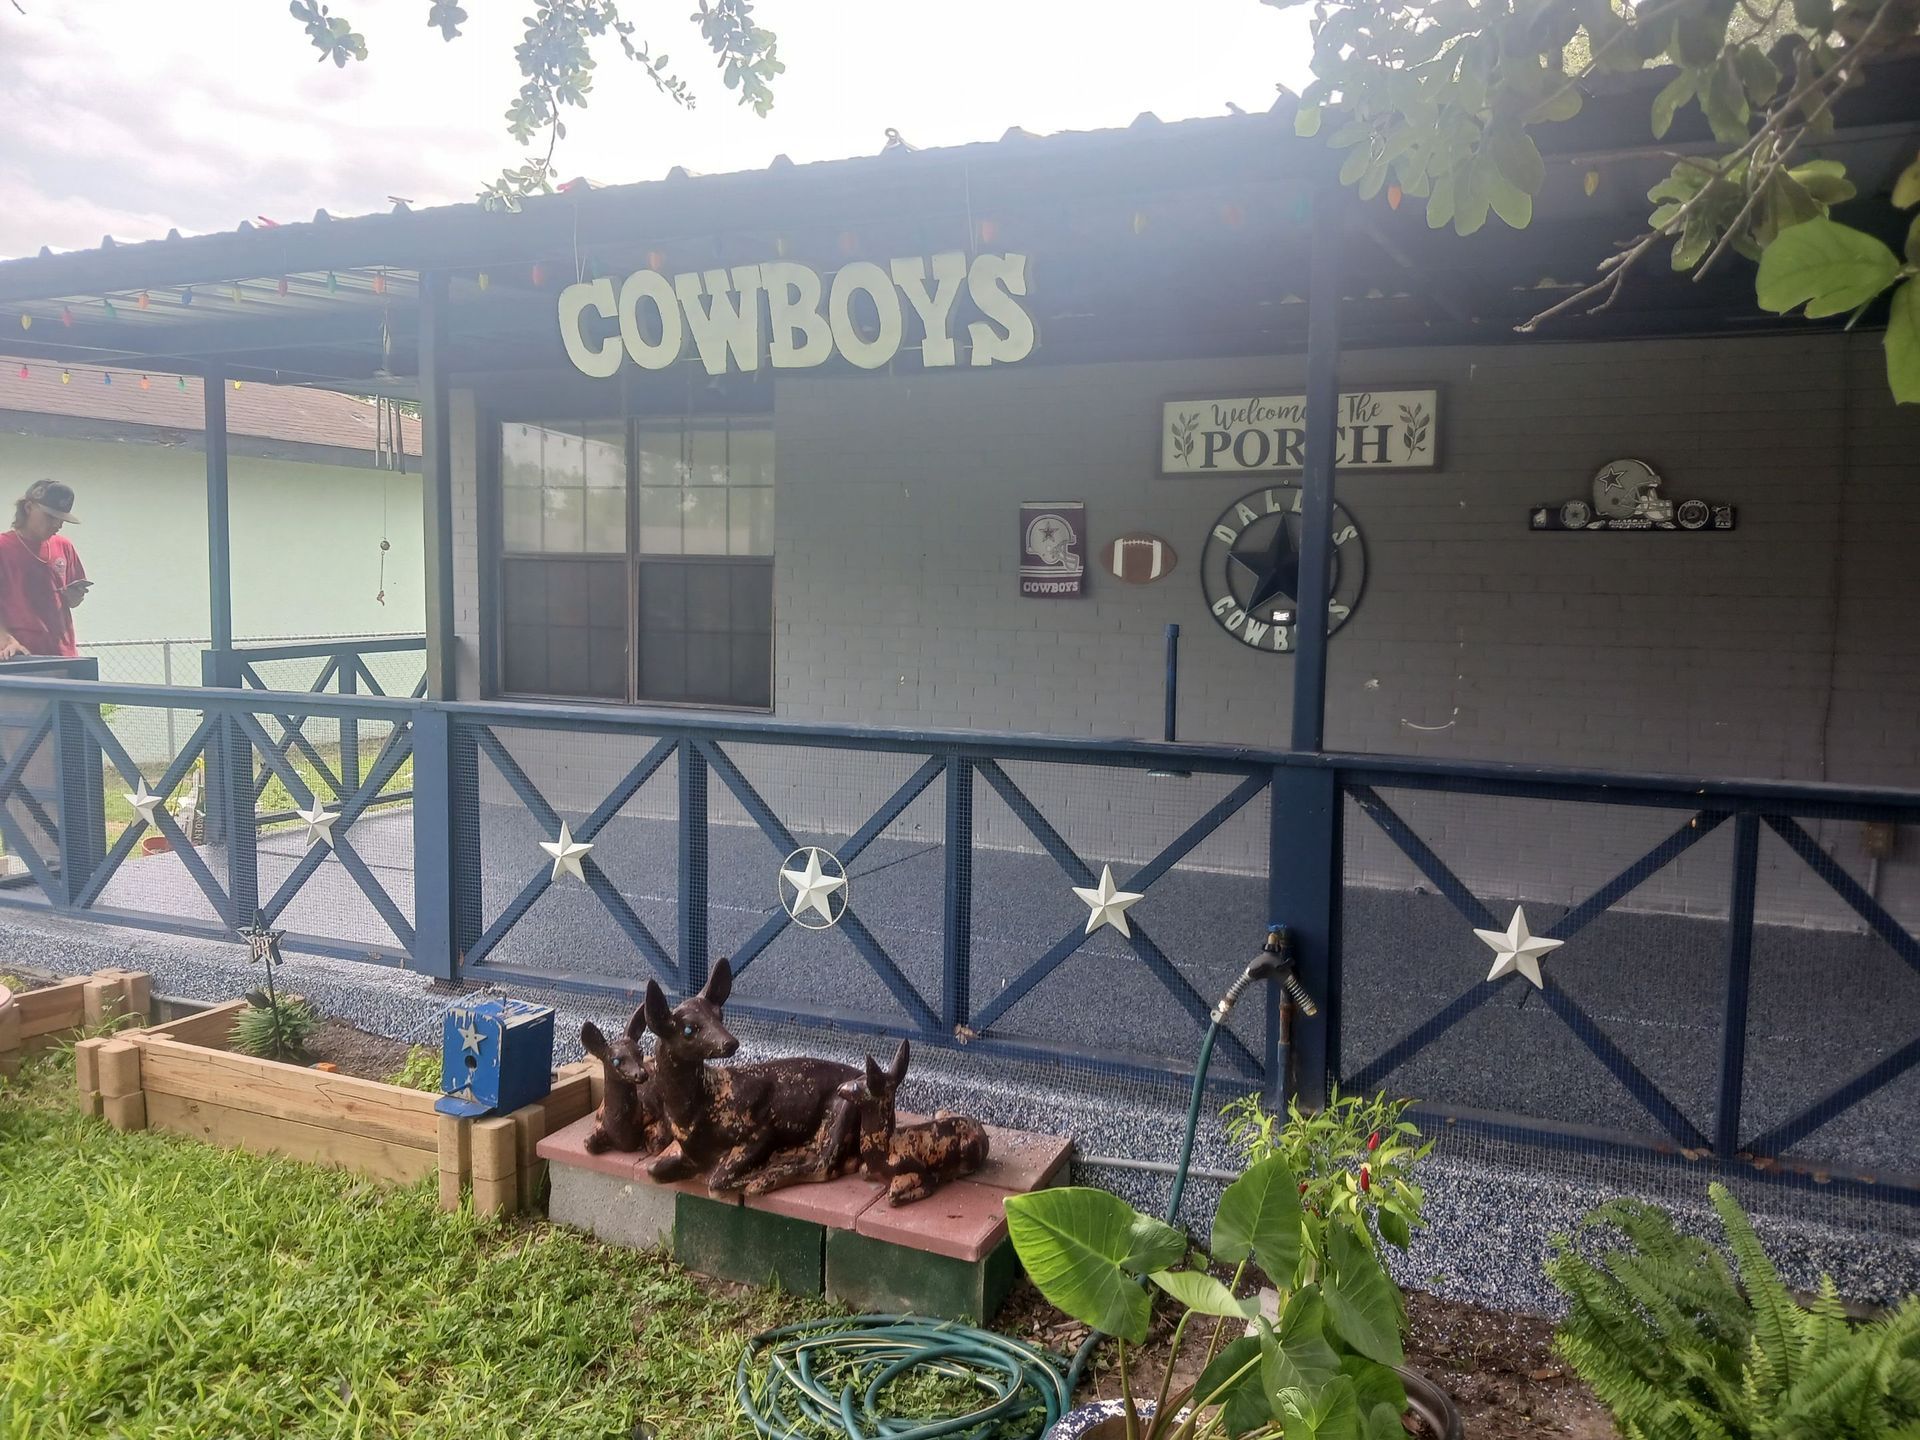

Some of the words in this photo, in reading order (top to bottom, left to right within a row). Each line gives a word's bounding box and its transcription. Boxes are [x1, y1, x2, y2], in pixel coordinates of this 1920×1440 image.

[558, 252, 1036, 377] COWBOYS
[1345, 393, 1383, 423] The
[1212, 488, 1358, 546] DALLS
[1022, 580, 1079, 594] COWBOYS
[1212, 595, 1351, 651] COWBS
